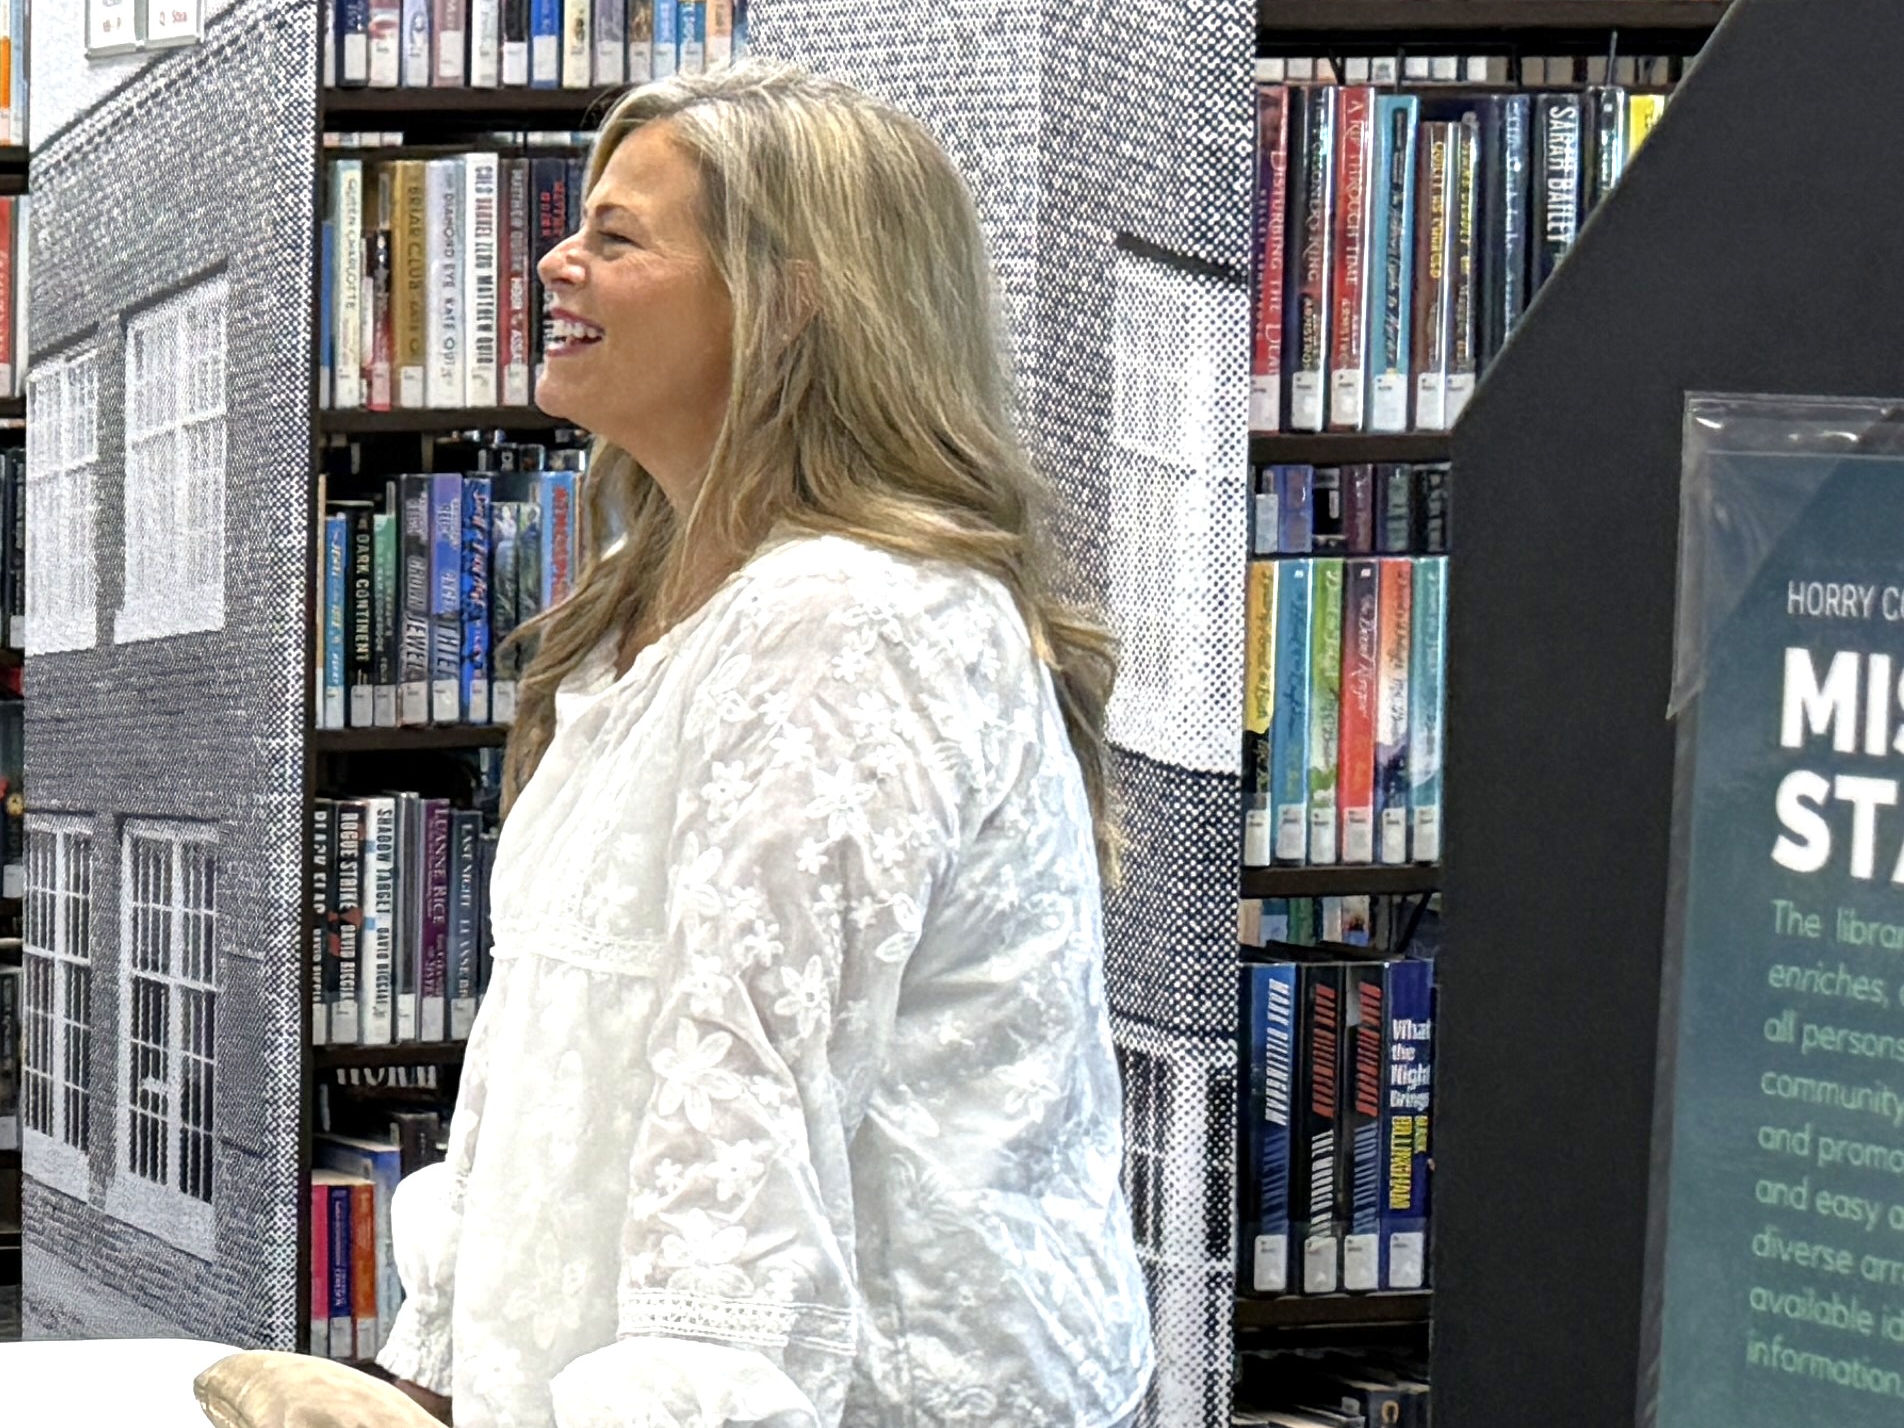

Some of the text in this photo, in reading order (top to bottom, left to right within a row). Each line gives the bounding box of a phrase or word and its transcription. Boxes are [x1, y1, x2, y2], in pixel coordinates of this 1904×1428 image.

[1345, 154, 1361, 239] THROUGH
[1546, 106, 1577, 245] SARAH BAILEY
[407, 186, 421, 290] BRIAR CLUB
[1269, 150, 1287, 271] DISTURBING
[443, 193, 455, 288] DIAMOND EYE
[1345, 245, 1359, 286] TIME
[444, 297, 454, 330] KATE
[476, 274, 493, 332] MATTHEW
[1269, 280, 1281, 311] THE
[355, 534, 370, 662] DARK CONTINENT
[1787, 580, 1876, 620] HORRY
[405, 612, 427, 672] JEWEL
[339, 813, 358, 909] ROGUE STRIKE
[376, 809, 392, 914] SHADOW TARGET
[433, 808, 447, 925] LUANNE RICE
[460, 824, 473, 909] LAST NIGHT
[340, 924, 356, 959] DAVID
[376, 928, 390, 960] DAVID
[1770, 899, 1822, 938] The
[1768, 960, 1889, 1008] enriches,
[1763, 1008, 1798, 1043] all
[1757, 1123, 1812, 1157] and
[1754, 1176, 1882, 1232] and easy
[1751, 1224, 1854, 1275] diverse
[1749, 1286, 1874, 1337] available
